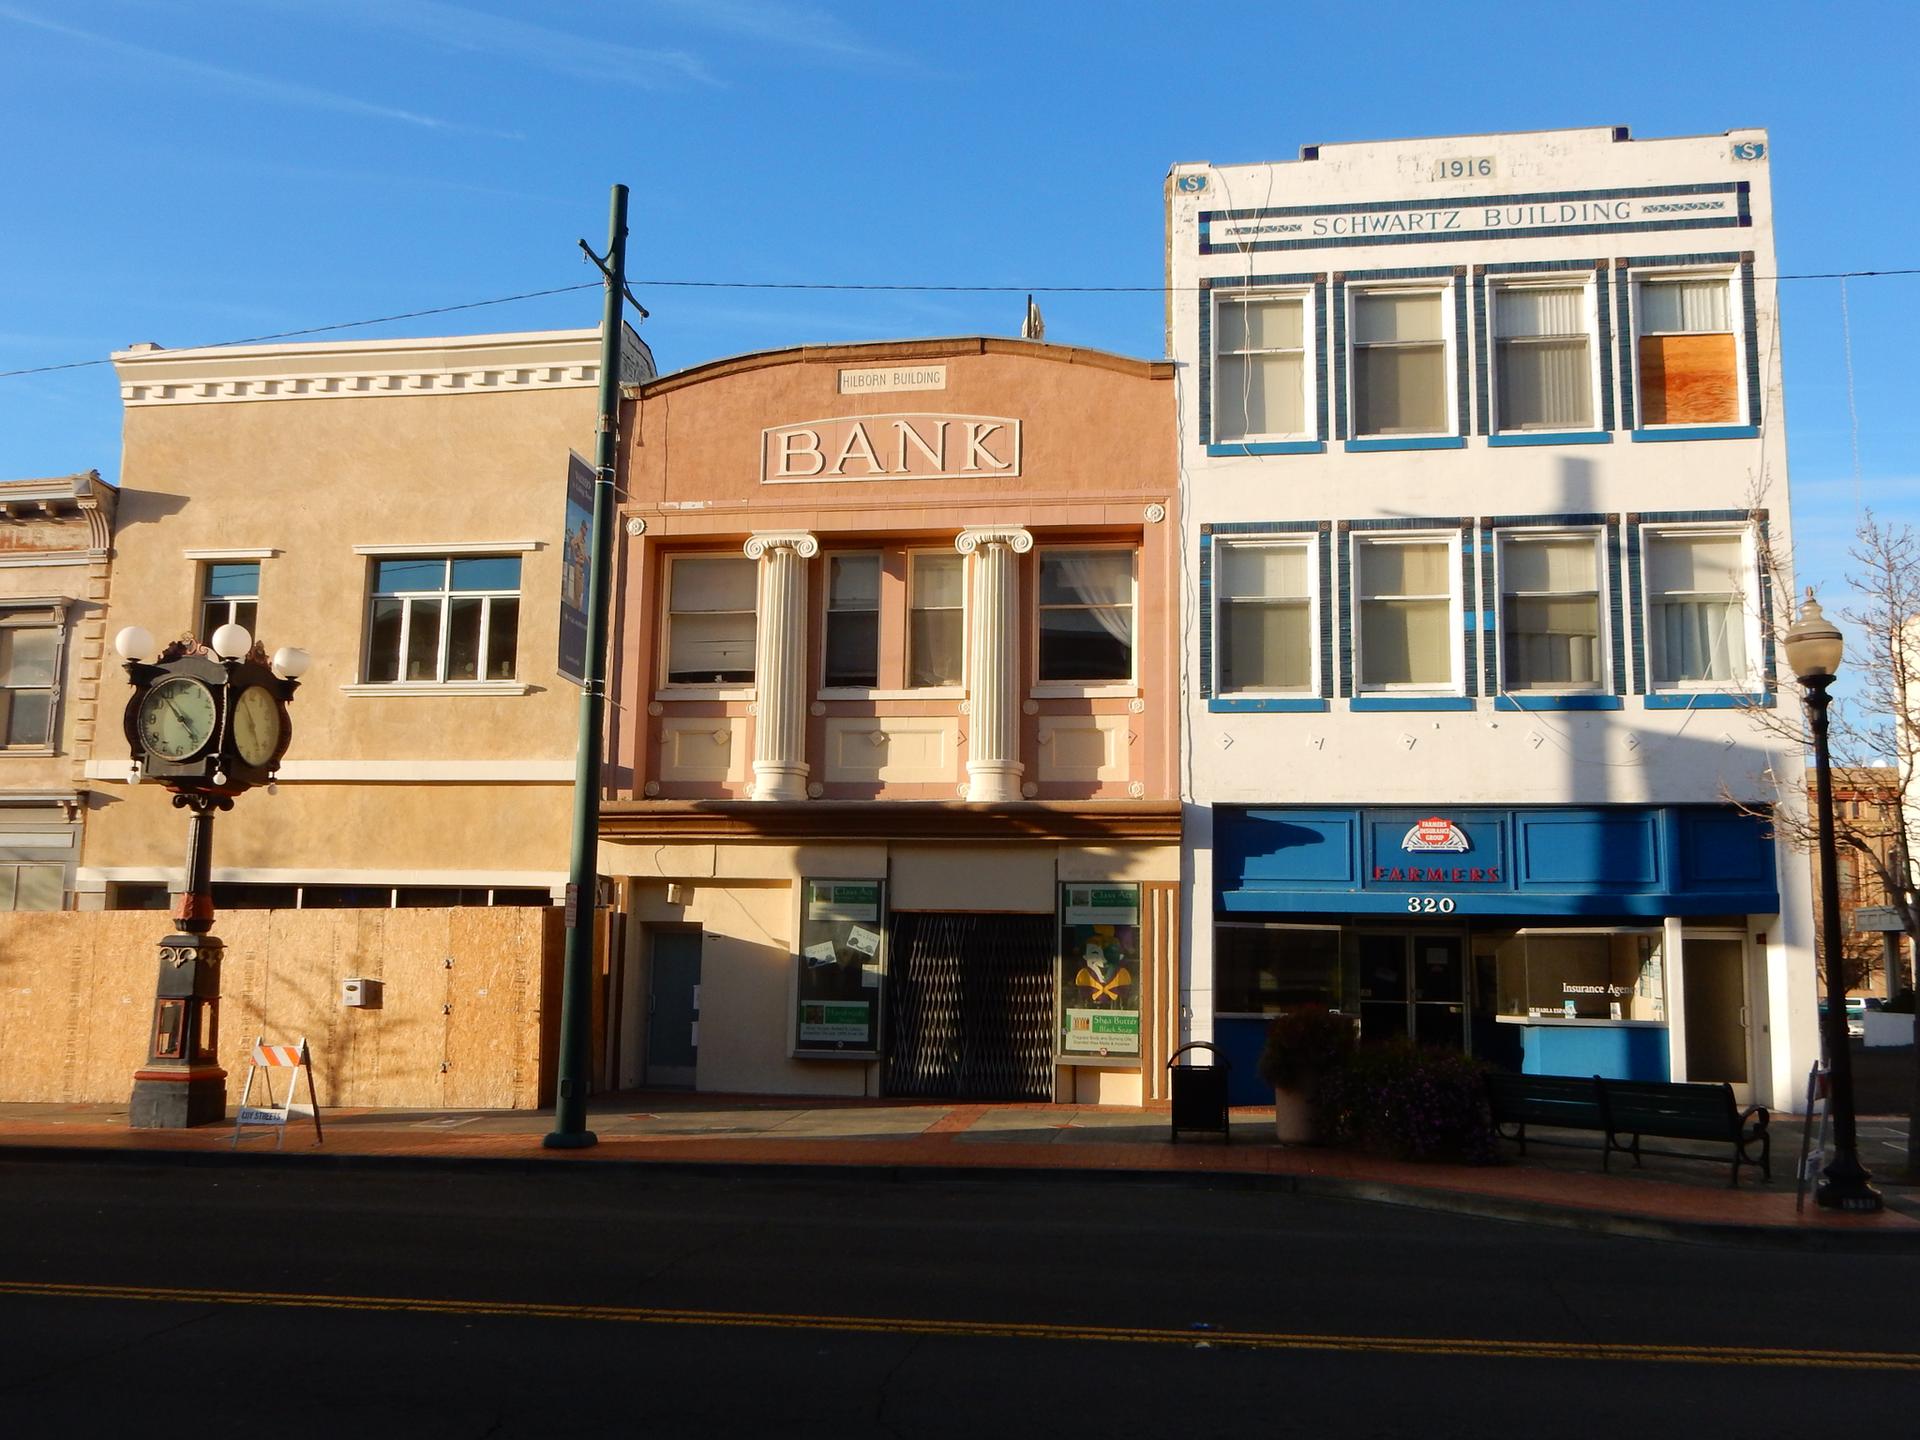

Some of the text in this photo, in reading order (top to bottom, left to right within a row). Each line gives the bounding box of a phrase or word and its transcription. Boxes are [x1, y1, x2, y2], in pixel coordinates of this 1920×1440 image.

[1739, 140, 1758, 159] S
[1439, 158, 1491, 180] 1916
[1185, 174, 1200, 192] S
[1312, 200, 1632, 237] SCHWARTZ BUILDING
[842, 370, 941, 389] HILBORN BUILDING
[776, 420, 1012, 477] BANK
[1374, 867, 1498, 882] FARMERS
[1408, 896, 1455, 913] 320
[1563, 983, 1638, 996] Insurance Agenc
[1093, 1015, 1137, 1025] Shea Butter
